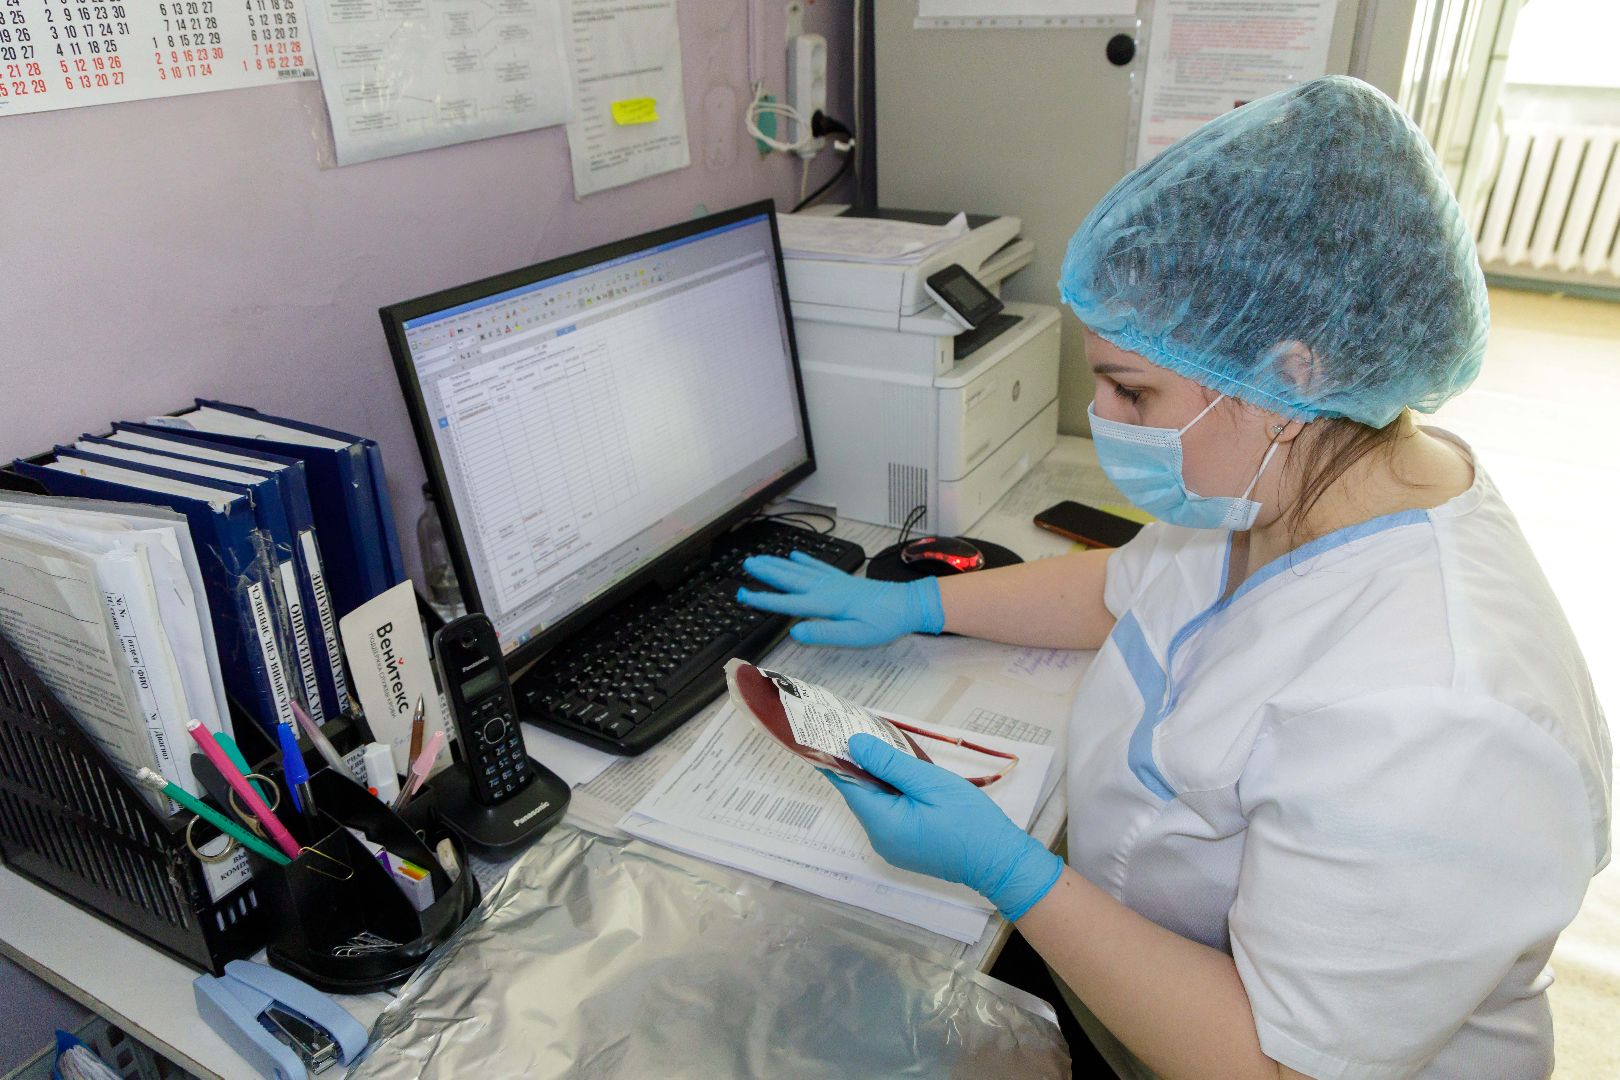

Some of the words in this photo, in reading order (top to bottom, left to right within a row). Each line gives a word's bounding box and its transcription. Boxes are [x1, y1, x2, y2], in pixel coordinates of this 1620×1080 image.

[160, 4, 166, 16] 6
[172, 3, 183, 15] 13
[186, 2, 198, 14] 20
[202, 2, 213, 13] 27
[257, 0, 265, 10] 11
[10, 11, 25, 24] 25
[45, 9, 53, 22] 2
[64, 8, 72, 21] 9
[78, 8, 90, 20] 16
[95, 7, 108, 19] 23
[112, 6, 126, 18] 30
[248, 15, 255, 26] 5
[260, 14, 268, 25] 12
[274, 13, 282, 24] 19
[286, 13, 297, 24] 26
[50, 27, 58, 39] 3
[64, 25, 77, 38] 10
[83, 24, 94, 37] 17
[99, 23, 113, 36] 24
[117, 22, 130, 34] 31
[164, 20, 169, 32] 7
[176, 19, 186, 30] 14
[190, 18, 200, 30] 21
[206, 17, 218, 28] 28
[16, 28, 30, 41] 26
[153, 37, 157, 48] 1
[168, 36, 174, 48] 8
[180, 35, 190, 46] 15
[193, 34, 205, 45] 22
[209, 33, 221, 44] 29
[251, 30, 257, 41] 6
[262, 29, 271, 40] 13
[275, 28, 285, 39] 20
[289, 27, 298, 38] 27
[1, 47, 16, 60] 20
[21, 46, 34, 59] 27
[56, 44, 63, 56] 4
[70, 42, 82, 55] 11
[88, 41, 100, 53] 18
[104, 40, 117, 52] 25
[155, 53, 162, 64] 2
[172, 52, 178, 63] 9
[184, 50, 193, 62] 16
[197, 49, 208, 60] 23
[212, 48, 223, 59] 30
[254, 44, 259, 55] 7
[265, 44, 274, 54] 14
[278, 43, 287, 53] 21
[7, 64, 21, 77] 21
[26, 63, 41, 76] 28
[60, 60, 68, 73] 5
[74, 59, 87, 71] 12
[93, 58, 104, 70] 19
[108, 56, 121, 68] 26
[159, 69, 166, 80] 3
[171, 67, 181, 79] 10
[187, 66, 196, 78] 17
[200, 64, 212, 76] 24
[243, 61, 248, 72] 1
[256, 59, 262, 70] 8
[267, 58, 276, 69] 15
[280, 57, 289, 68] 22
[293, 56, 304, 67] 29
[12, 82, 28, 95] 22
[32, 80, 46, 93] 29
[65, 77, 73, 89] 6
[80, 75, 91, 88] 13
[95, 74, 108, 86] 20
[113, 72, 124, 84] 27
[312, 570, 342, 669] ПЕРЕЛИВАНИЕ
[291, 603, 319, 700] УТИЛИЗАЦИЮ
[462, 656, 490, 672] Panasonic
[138, 670, 148, 689] ФИО
[311, 703, 324, 722] НА
[513, 801, 550, 828] Panasonic
